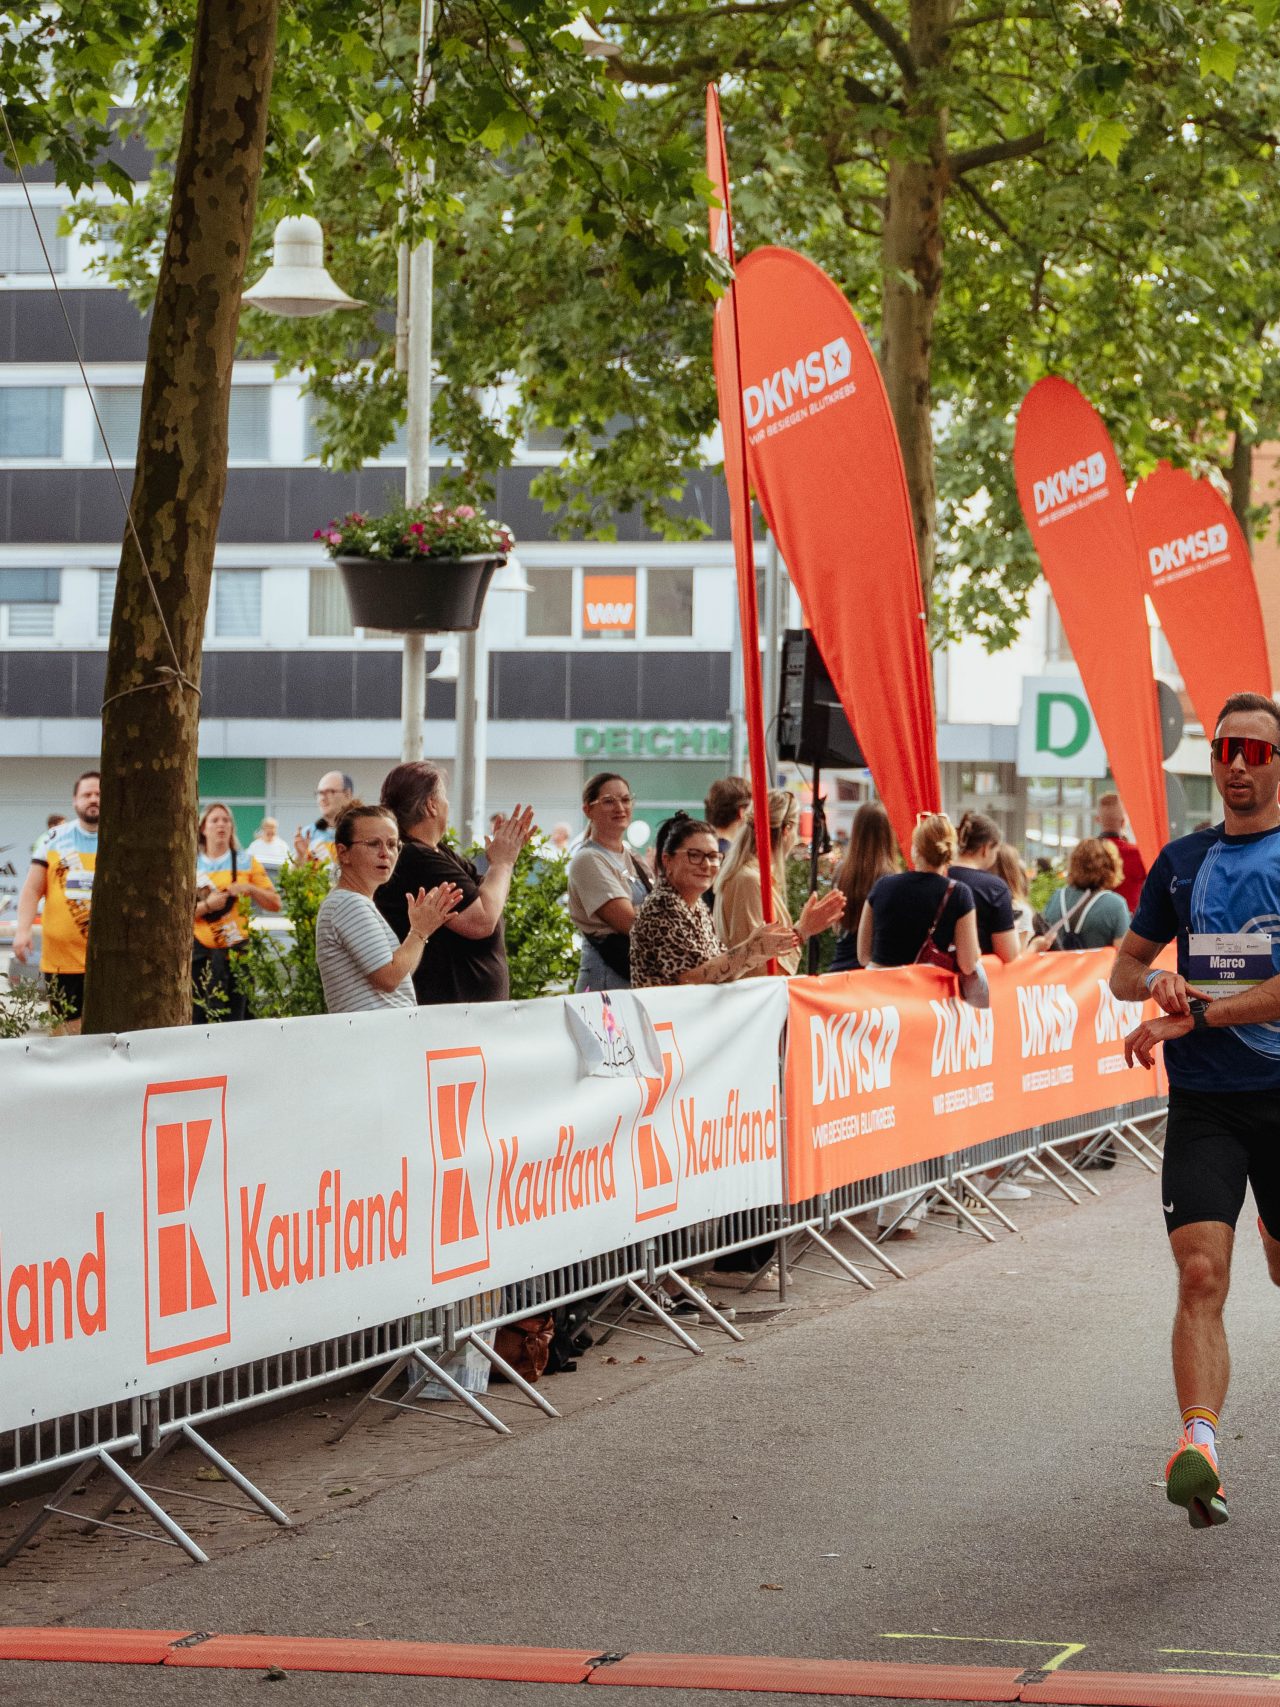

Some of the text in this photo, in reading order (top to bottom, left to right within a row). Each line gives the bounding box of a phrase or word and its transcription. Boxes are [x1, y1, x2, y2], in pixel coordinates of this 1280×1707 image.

[743, 351, 826, 429] DKMS
[1033, 460, 1090, 514] DKMS
[1149, 530, 1208, 576] DKMS
[574, 725, 732, 755] DEICHM
[1035, 691, 1092, 759] D
[1210, 956, 1246, 969] Marco
[1219, 971, 1235, 979] 1720
[809, 1007, 882, 1106] DKMS
[679, 1086, 777, 1177] Kaufland
[496, 1115, 622, 1231] Kaufland
[239, 1156, 408, 1297] Kaufland
[0, 1211, 106, 1355] and
